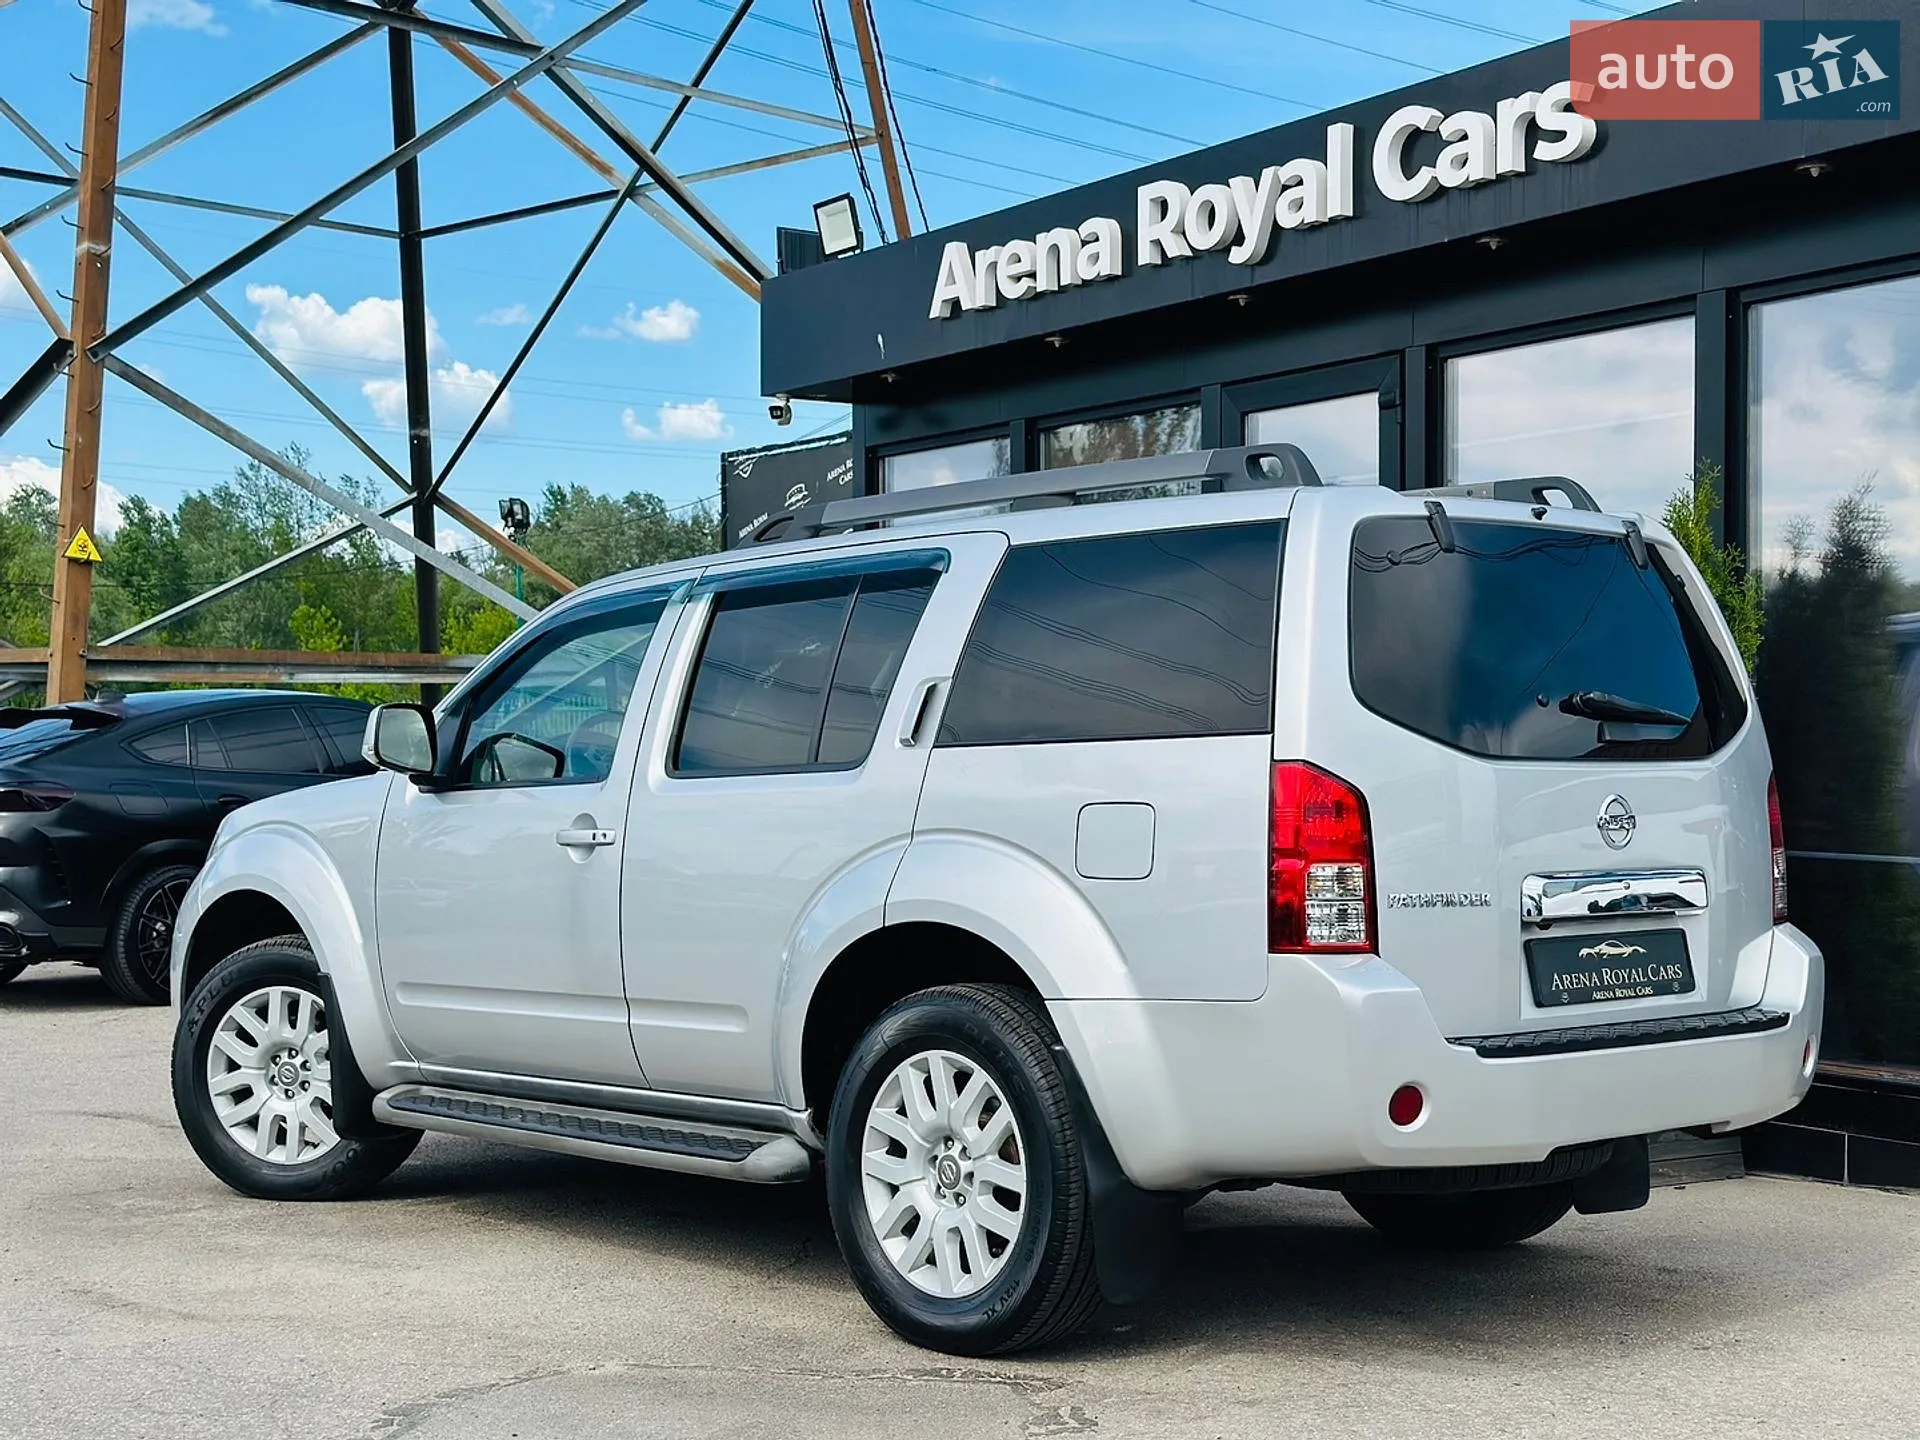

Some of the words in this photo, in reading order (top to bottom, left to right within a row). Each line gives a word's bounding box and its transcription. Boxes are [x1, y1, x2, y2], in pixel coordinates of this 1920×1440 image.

[929, 241, 1123, 320] Arena
[1136, 122, 1354, 265] Royal
[1372, 80, 1597, 203] Cars
[1387, 891, 1491, 909] PATHFINDER
[1551, 972, 1600, 991] ARENA
[1601, 966, 1647, 986] ROYAL
[1647, 963, 1683, 981] CARS
[1591, 990, 1615, 1000] ARENA
[1615, 987, 1636, 998] ROYAL
[1637, 985, 1654, 996] CARS
